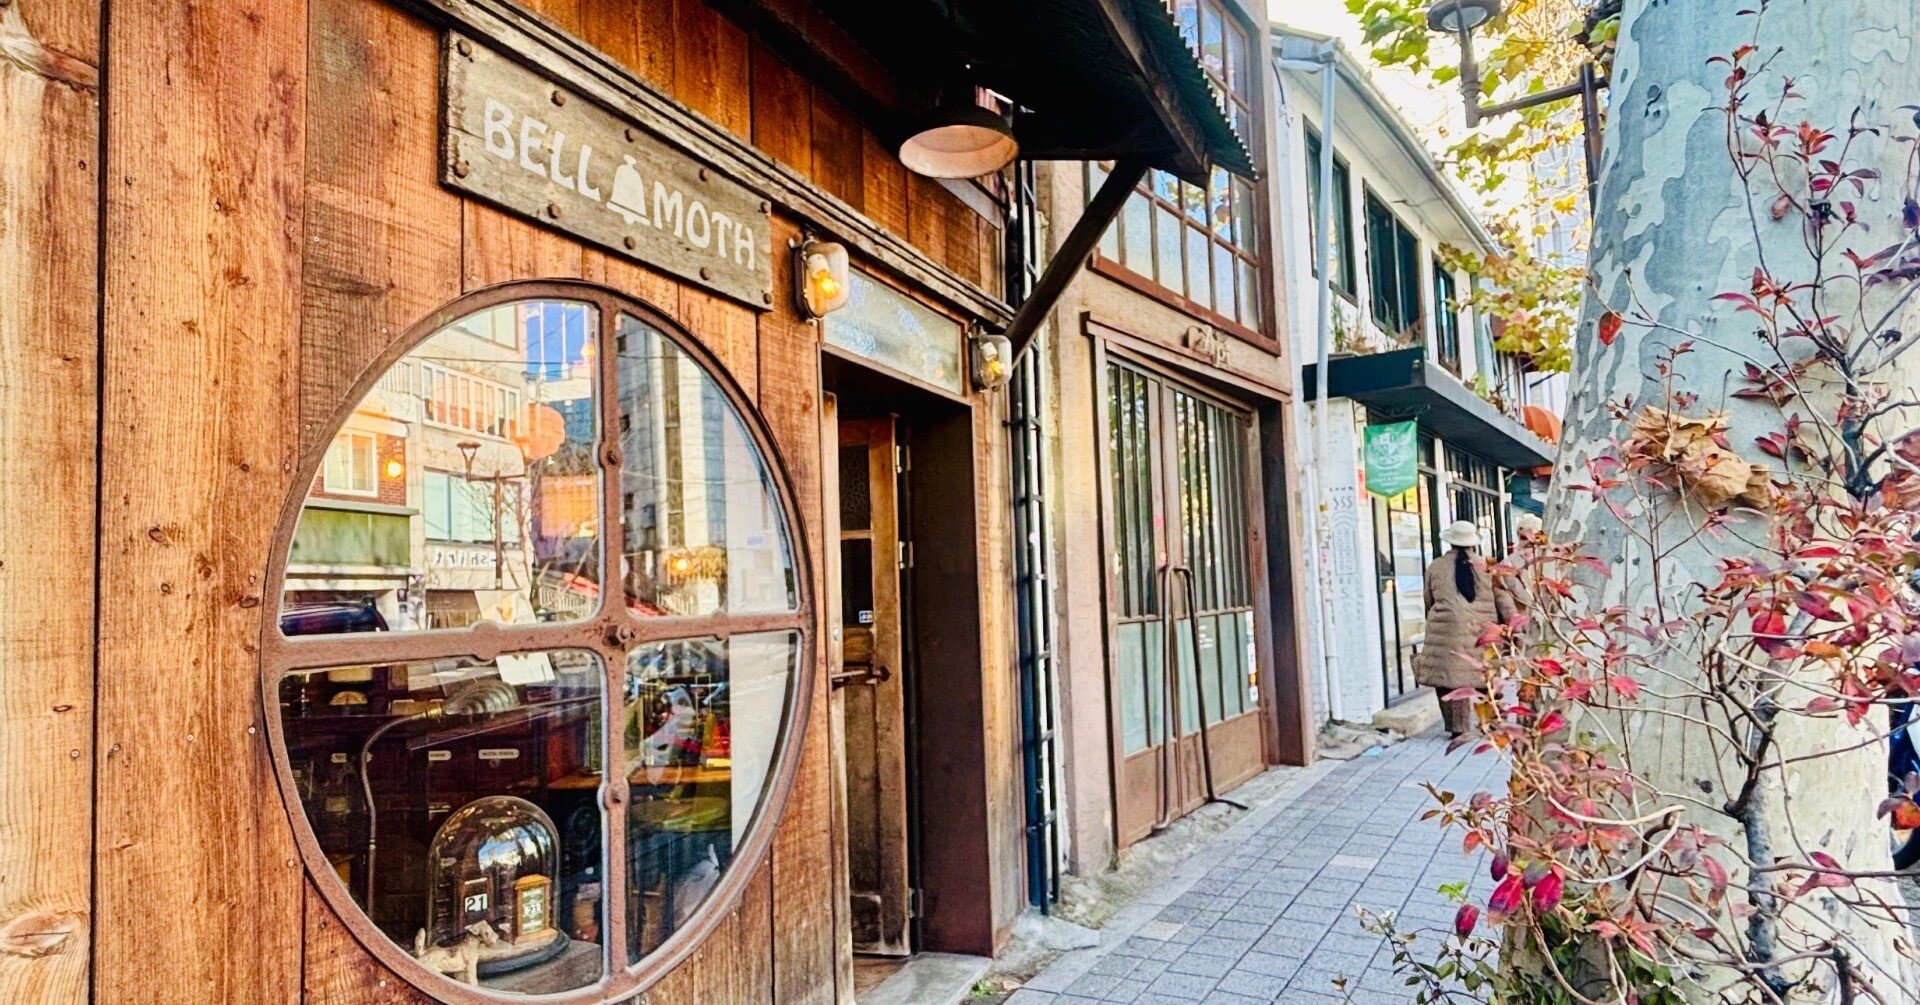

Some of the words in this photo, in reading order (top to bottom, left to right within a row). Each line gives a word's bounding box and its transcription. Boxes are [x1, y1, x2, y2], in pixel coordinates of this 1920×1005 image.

[484, 97, 601, 202] BELL
[653, 181, 756, 271] MOTH
[466, 896, 484, 912] 21
